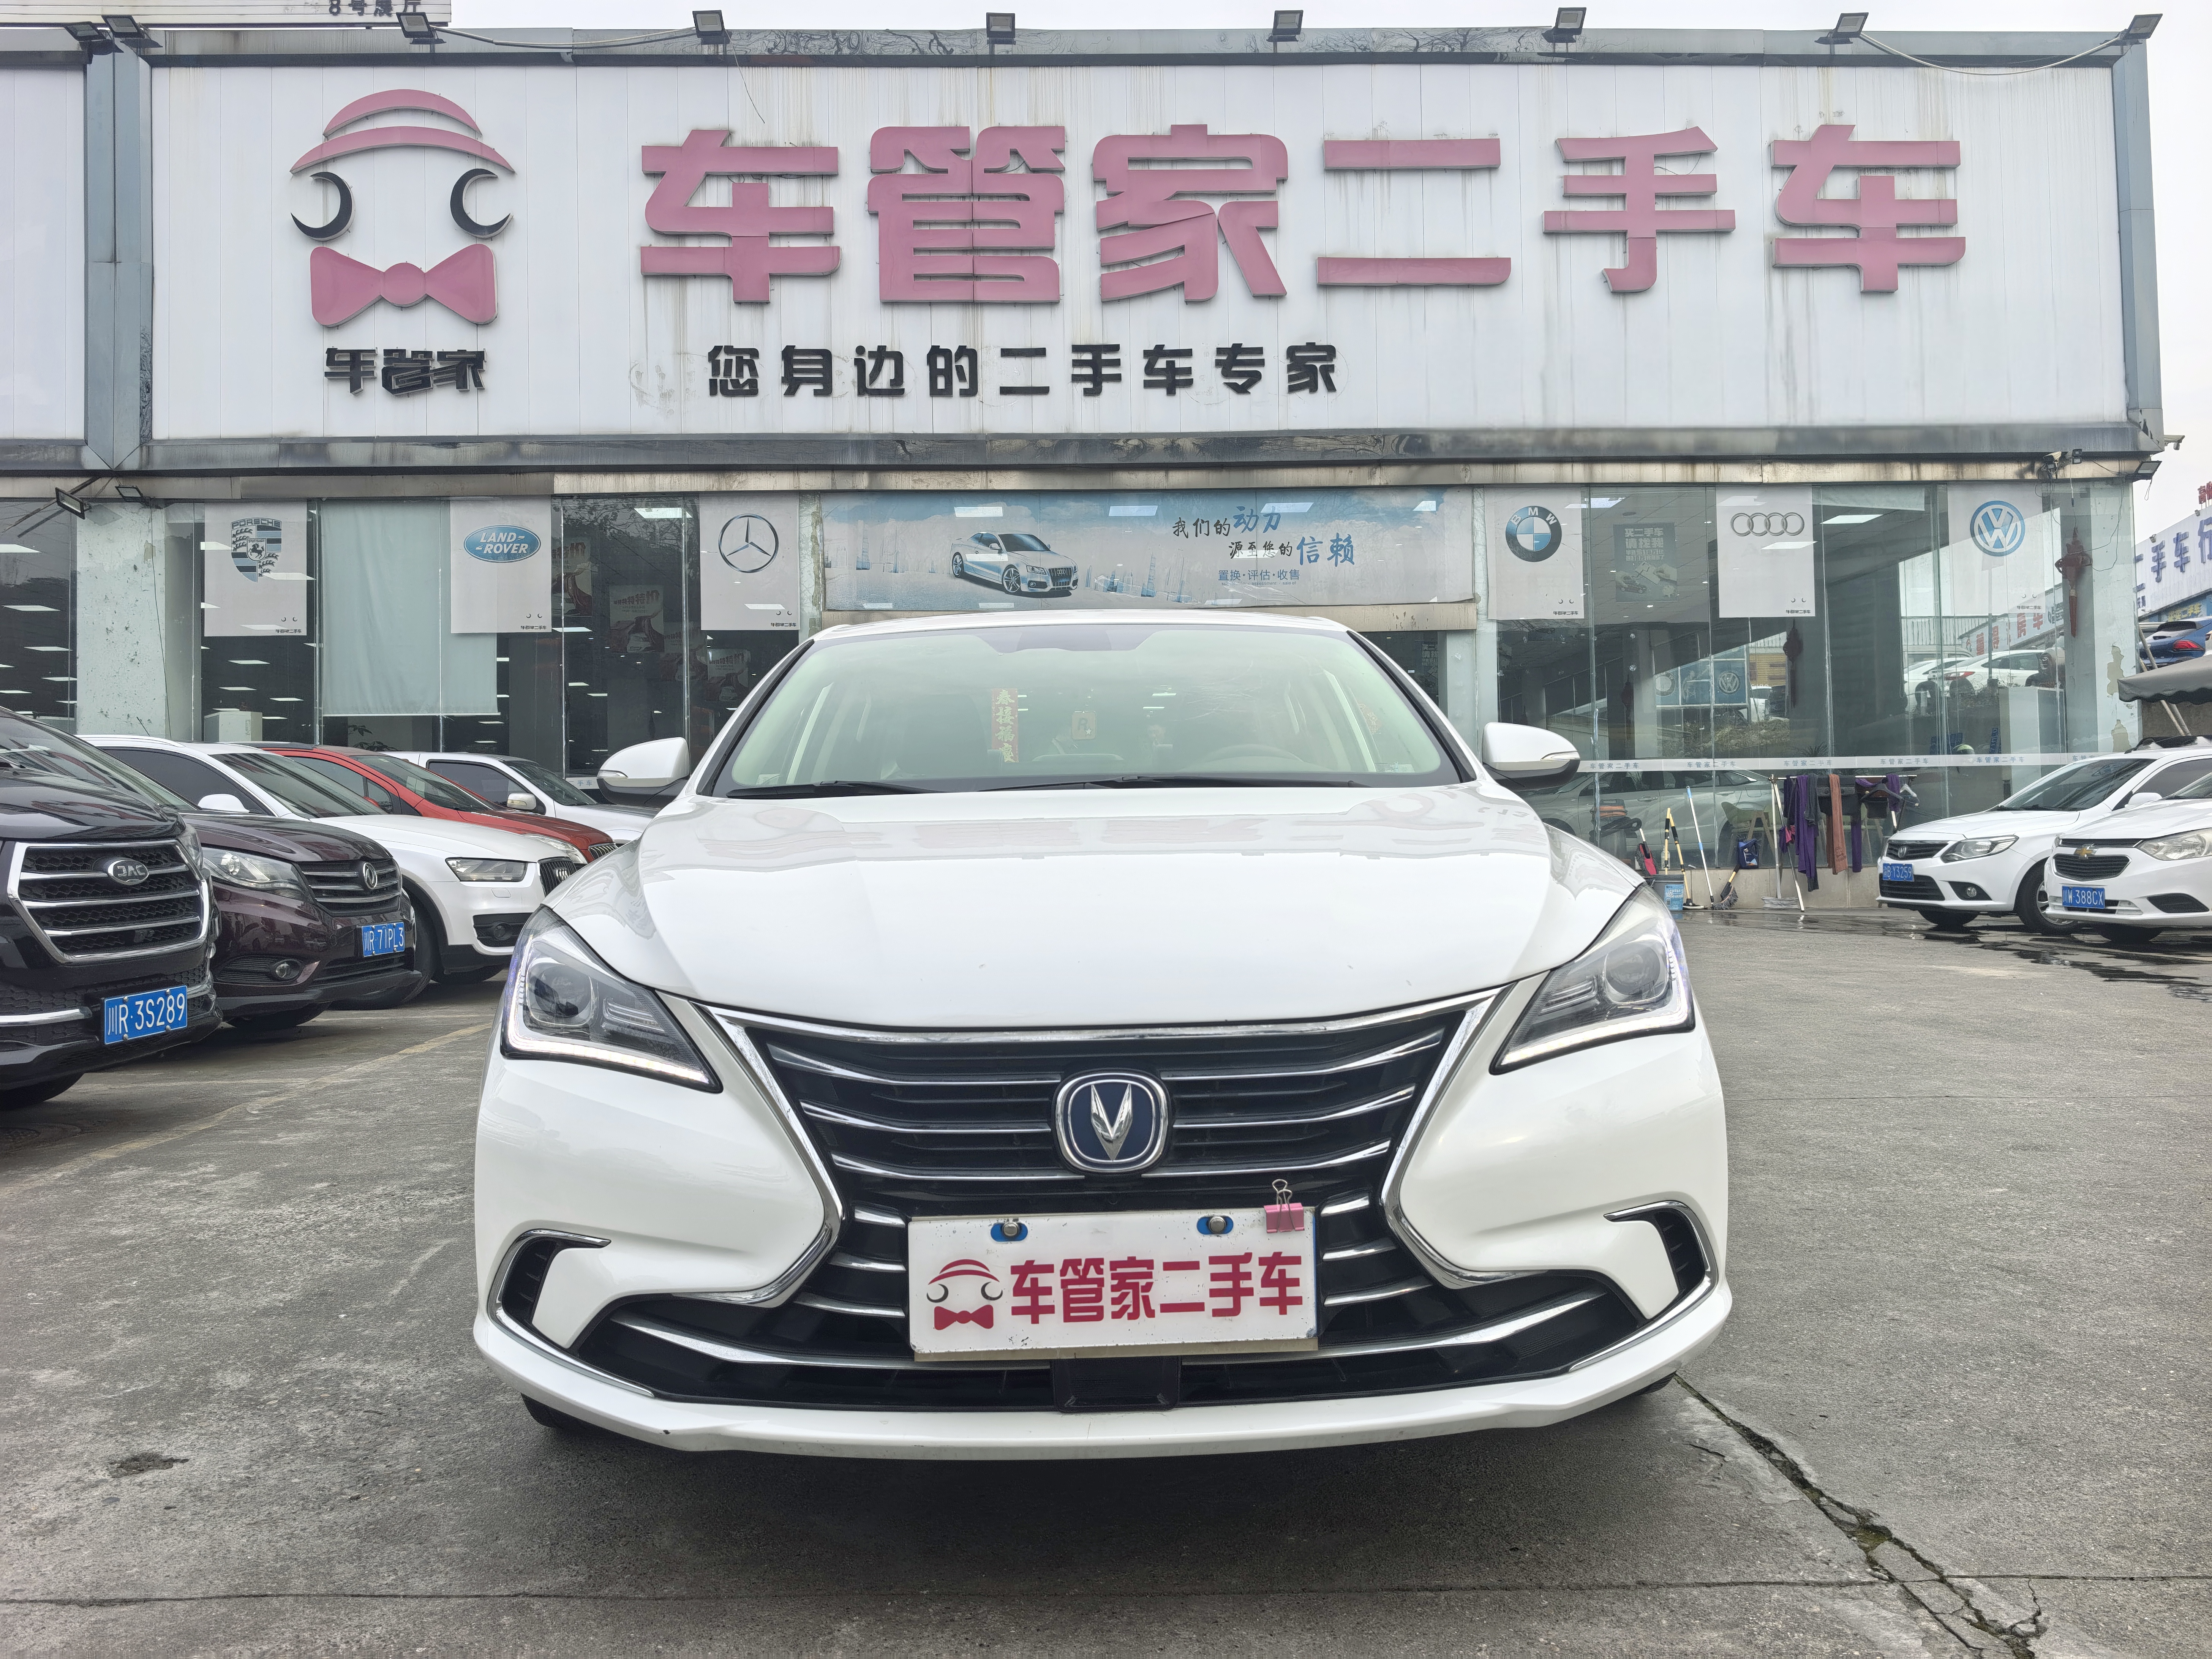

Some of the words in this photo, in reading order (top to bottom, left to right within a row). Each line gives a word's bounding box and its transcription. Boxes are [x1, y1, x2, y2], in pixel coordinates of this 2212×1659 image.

[640, 124, 1966, 304] 车管家二手车
[708, 342, 1337, 398] 您身边的二手车专家
[232, 519, 281, 529] PORSCHE
[1511, 507, 1558, 525] BMW
[1010, 1251, 1303, 1325] 车管家二手车
